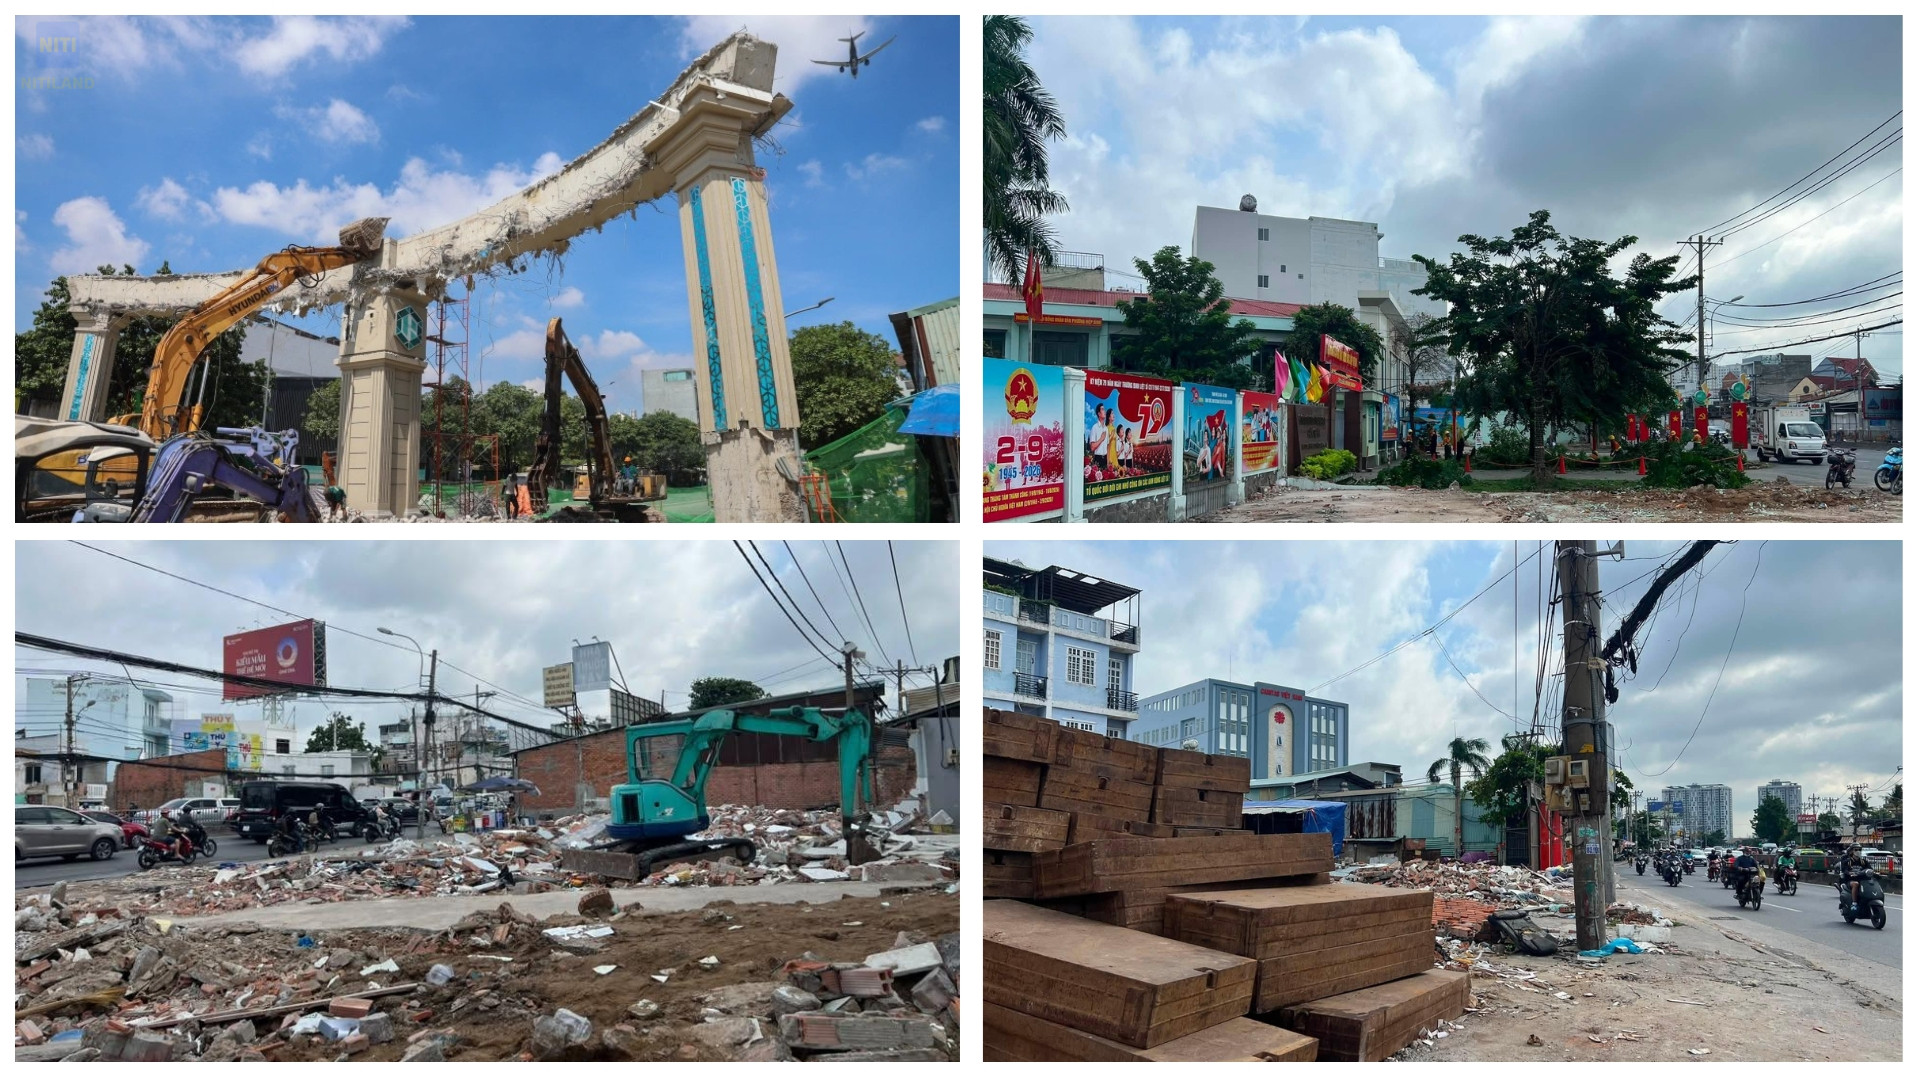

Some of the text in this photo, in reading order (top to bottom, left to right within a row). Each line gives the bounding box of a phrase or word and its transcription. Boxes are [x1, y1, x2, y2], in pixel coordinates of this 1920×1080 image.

[228, 286, 270, 316] HYUNDAI
[1138, 398, 1165, 440] 79
[999, 467, 1017, 480] 1945
